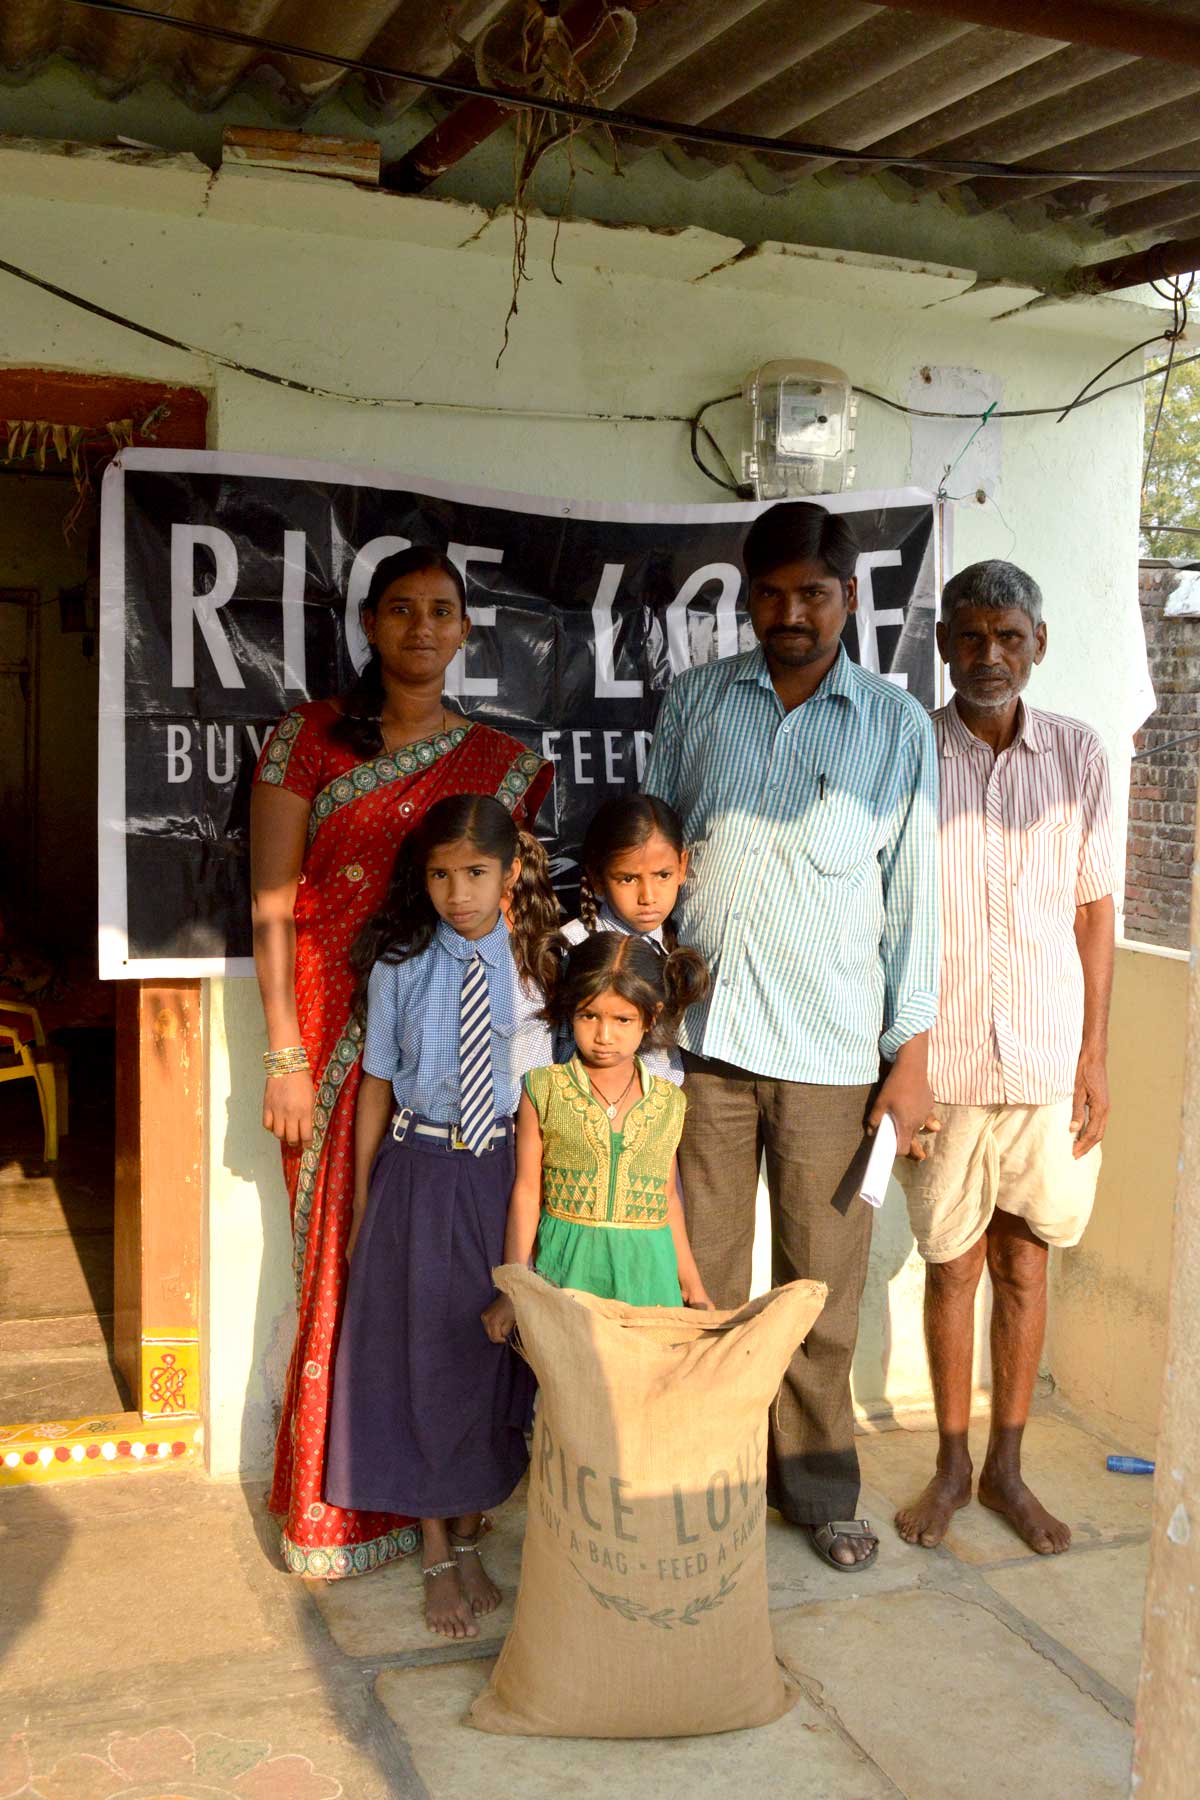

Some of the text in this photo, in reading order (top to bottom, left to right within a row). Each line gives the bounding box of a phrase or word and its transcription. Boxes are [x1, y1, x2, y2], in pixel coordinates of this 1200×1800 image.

[170, 522, 908, 699] RICE LOE
[538, 1420, 638, 1544] RICE
[570, 1529, 580, 1553] A
[588, 1539, 629, 1576] BAG
[658, 1552, 709, 1581] FEED
[718, 1543, 727, 1567] A
